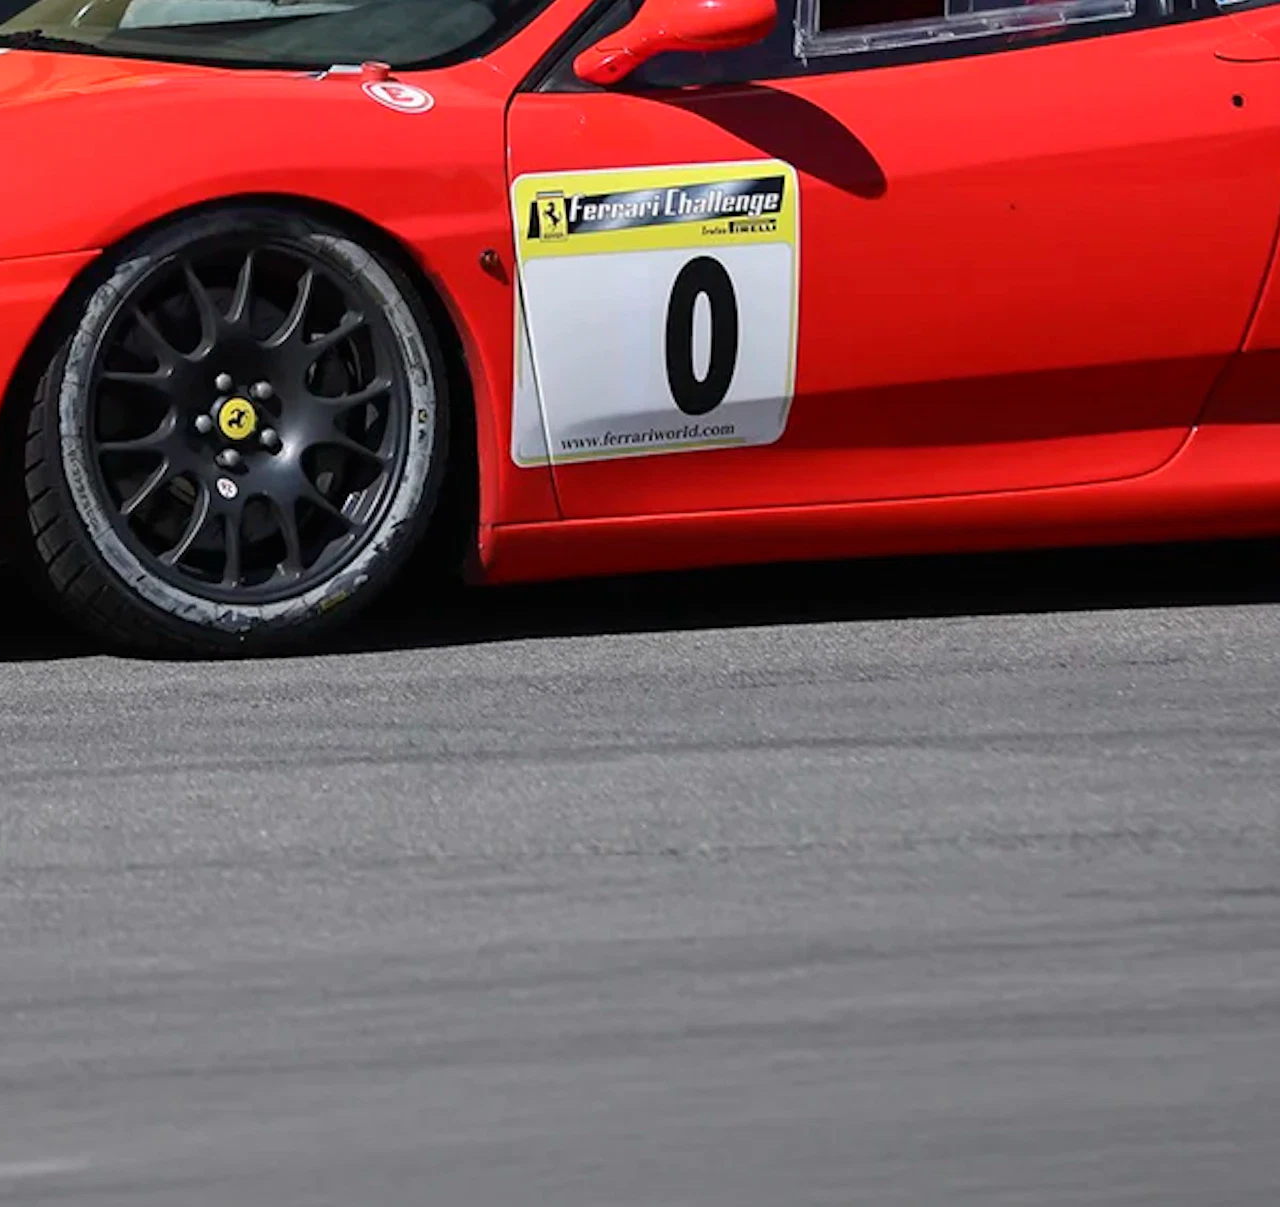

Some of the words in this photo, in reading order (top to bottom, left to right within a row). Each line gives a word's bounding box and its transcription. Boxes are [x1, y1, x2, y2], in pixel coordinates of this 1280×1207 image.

[569, 193, 661, 223] Ferrari
[664, 188, 780, 217] Challenge
[666, 255, 739, 415] 0
[561, 423, 735, 451] www.ferrariworld.com
